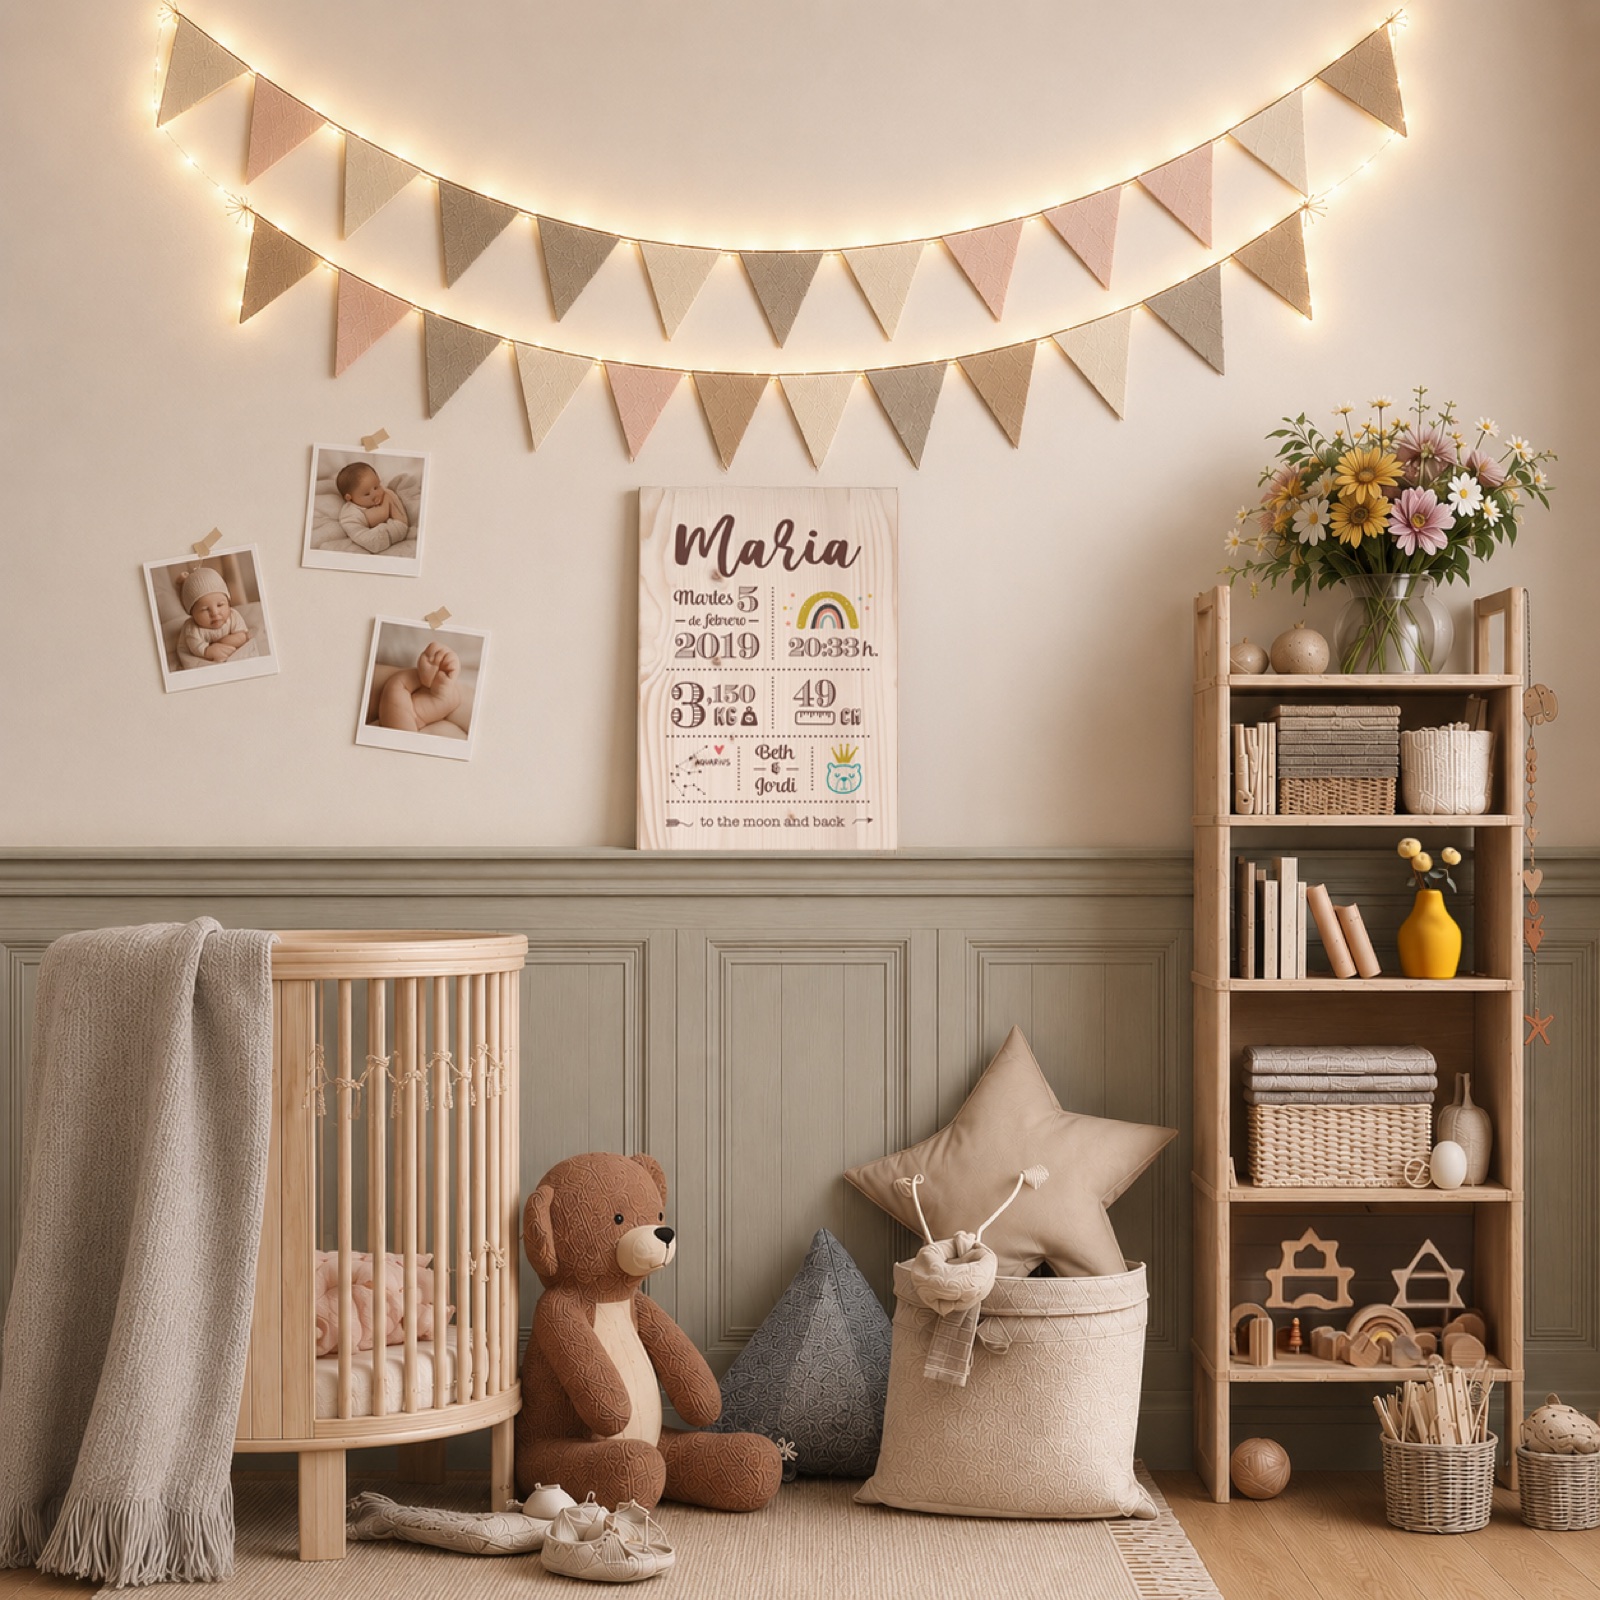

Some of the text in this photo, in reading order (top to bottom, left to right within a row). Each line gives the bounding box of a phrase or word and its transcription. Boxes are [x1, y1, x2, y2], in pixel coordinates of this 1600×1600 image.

[675, 514, 861, 578] Maria
[674, 586, 759, 613] Martes 5
[688, 613, 746, 629] de febrero
[675, 632, 760, 659] 2019
[793, 679, 837, 708] 49
[714, 706, 737, 726] KG
[840, 707, 861, 726] CM
[754, 743, 795, 760] Beth
[695, 758, 731, 766] AQUARIUS
[754, 777, 797, 796] Jordi
[700, 816, 845, 827] to the moon and back
